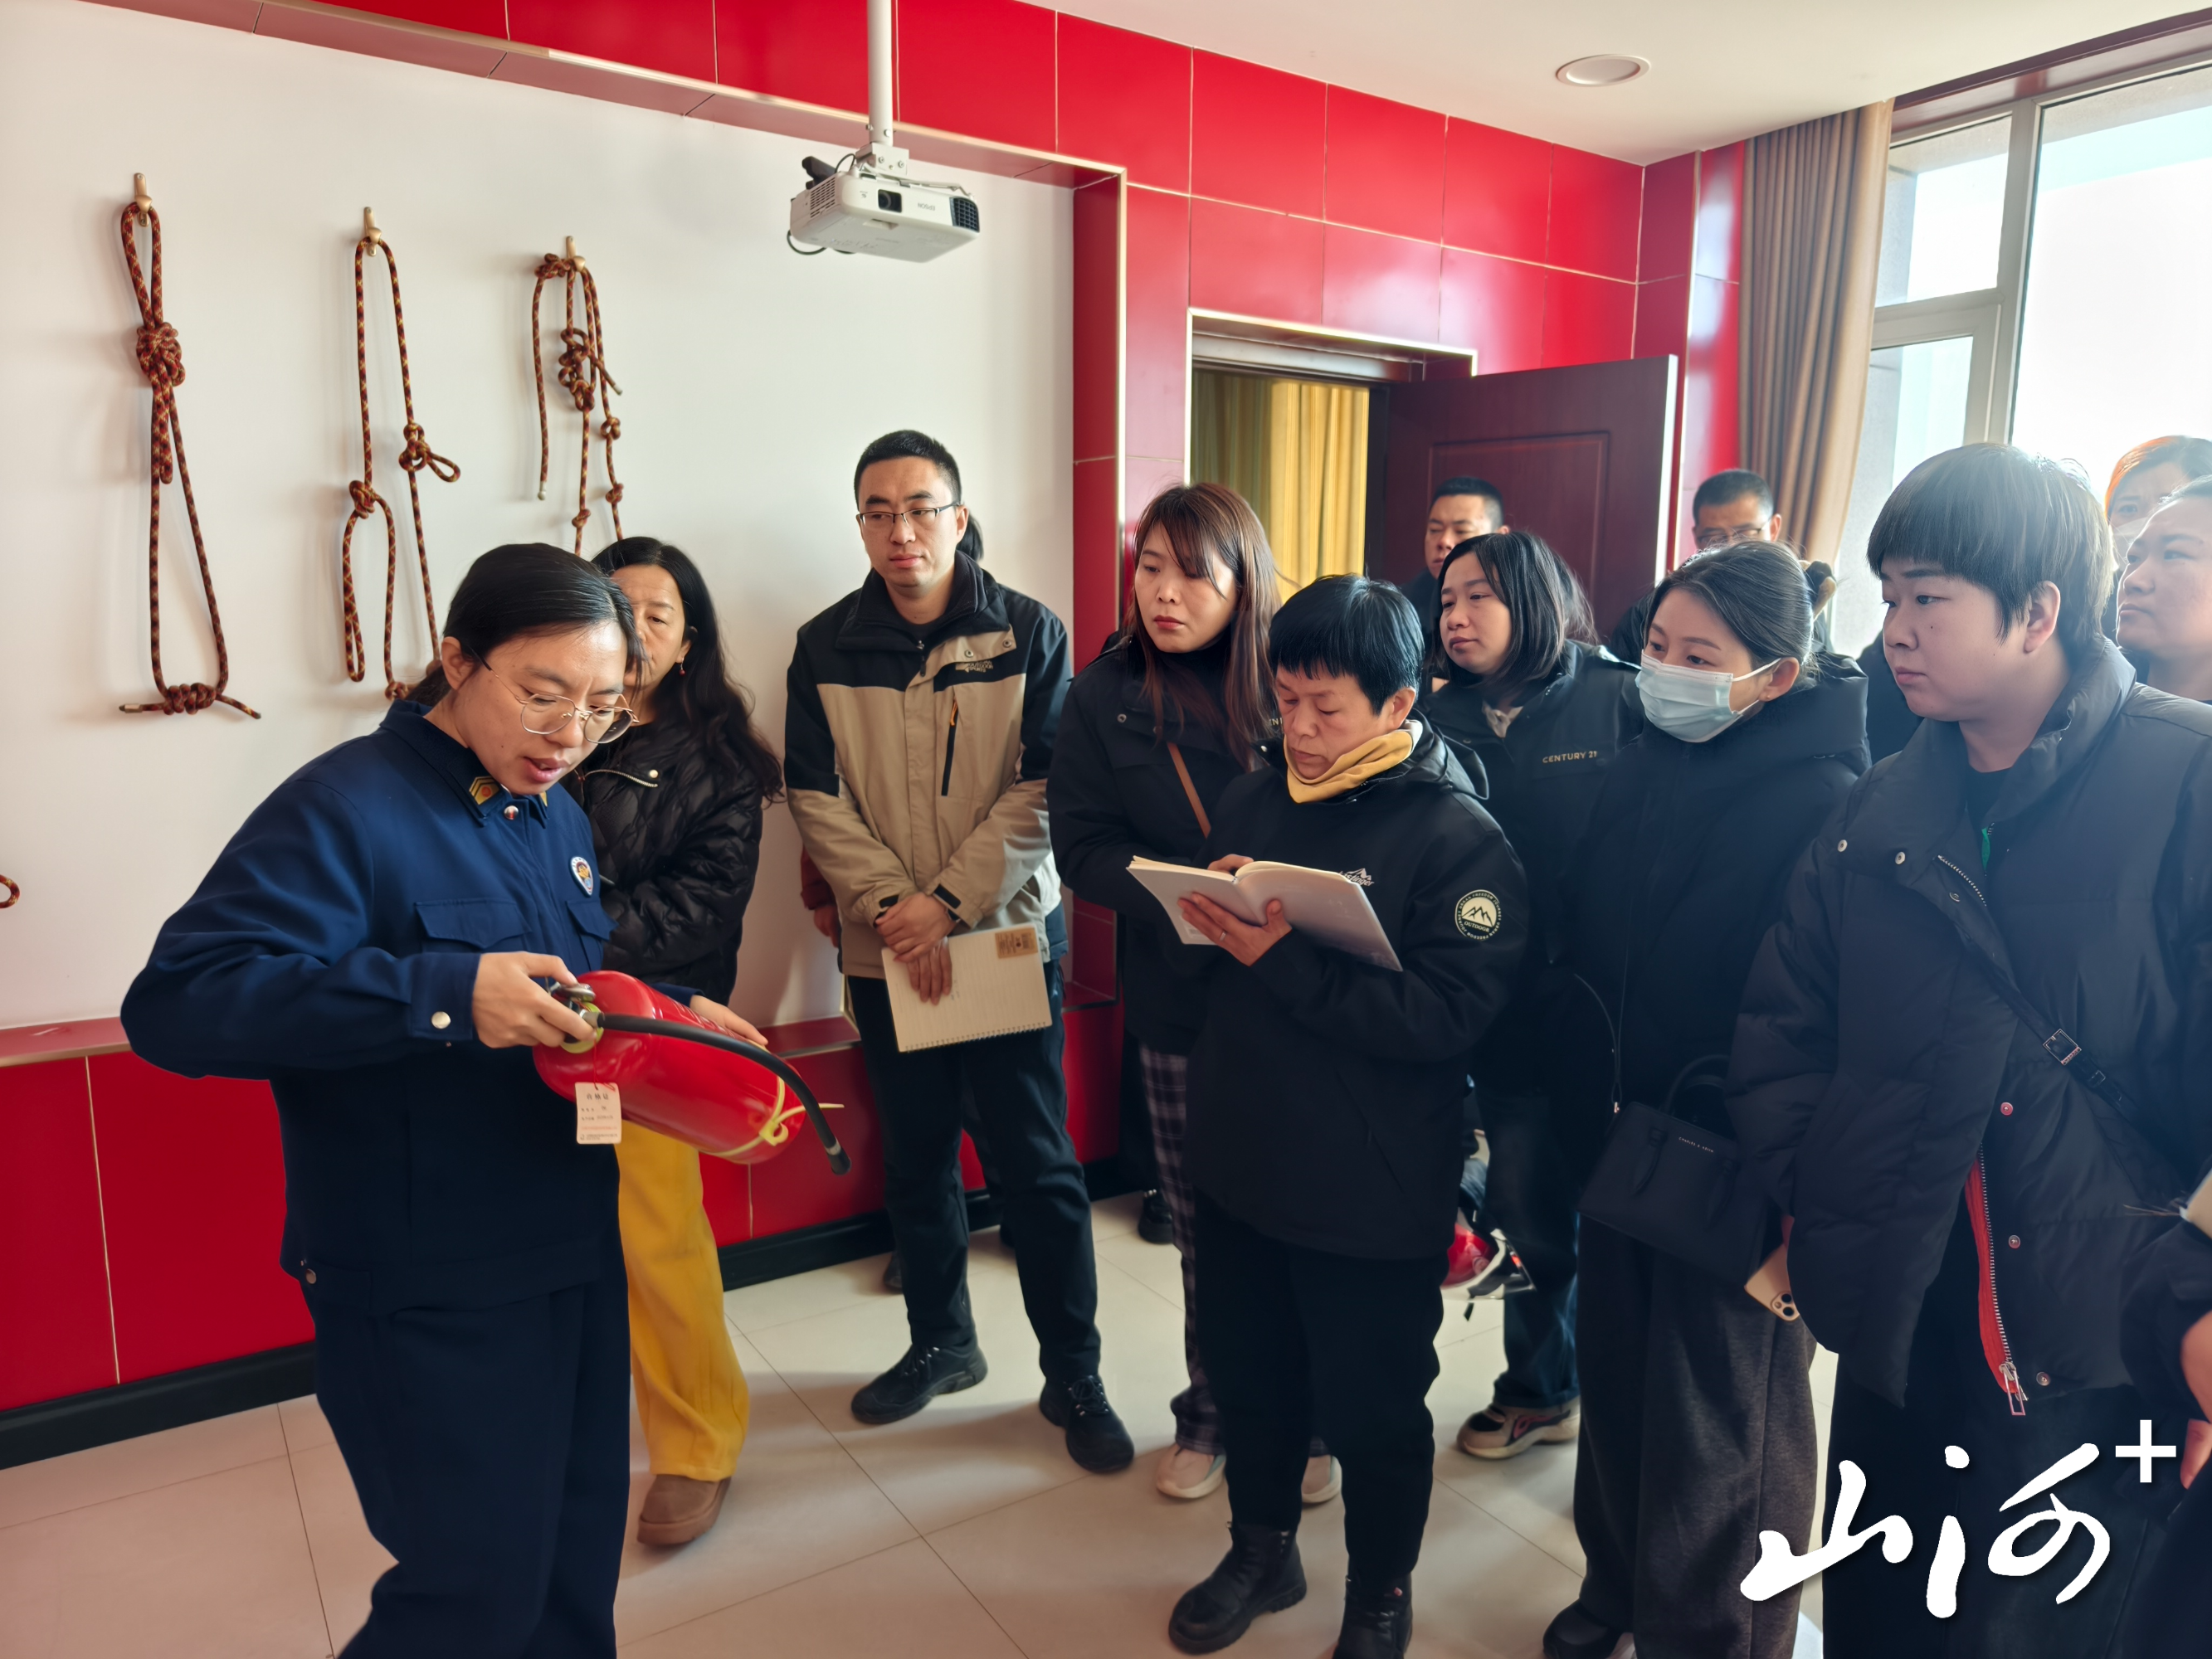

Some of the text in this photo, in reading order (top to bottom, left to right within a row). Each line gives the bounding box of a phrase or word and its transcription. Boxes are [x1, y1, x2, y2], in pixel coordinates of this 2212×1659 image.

[918, 202, 936, 212] EPSON
[1542, 751, 1598, 764] CENTURY 21
[1464, 921, 1490, 933] OUTDOOR
